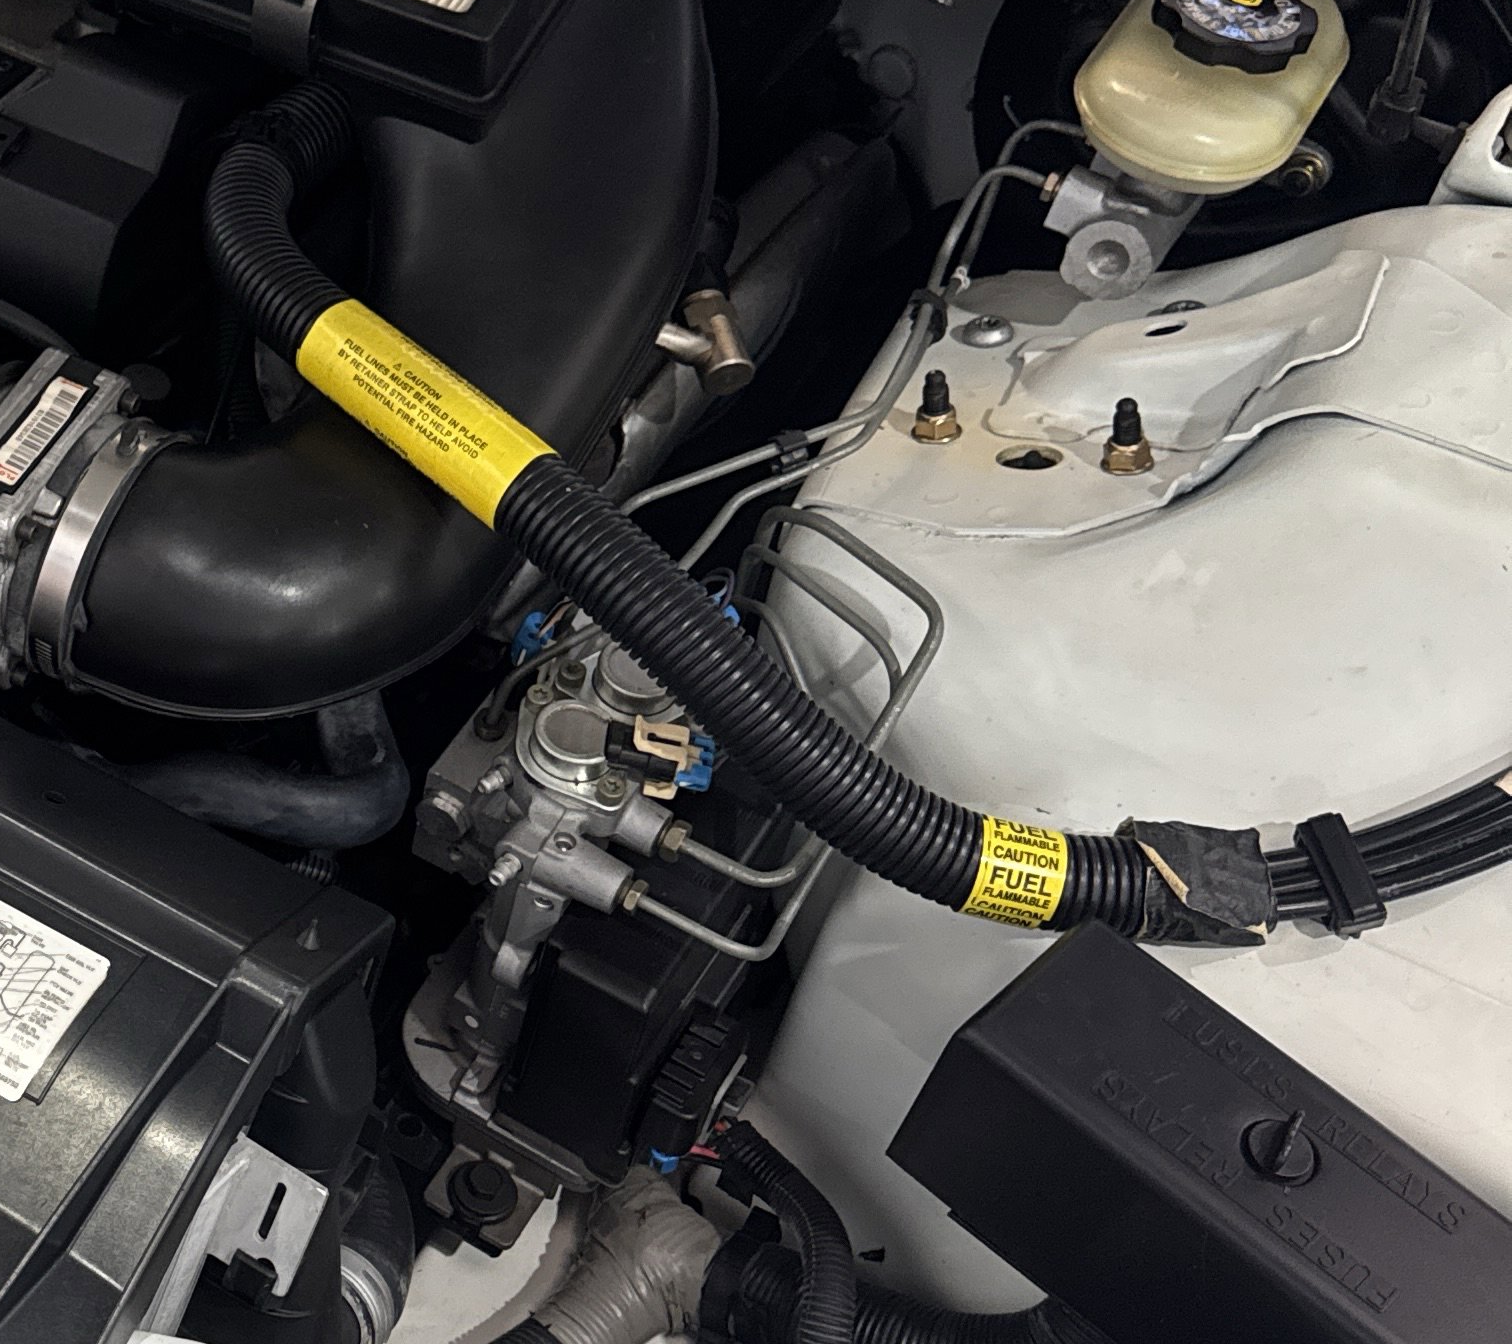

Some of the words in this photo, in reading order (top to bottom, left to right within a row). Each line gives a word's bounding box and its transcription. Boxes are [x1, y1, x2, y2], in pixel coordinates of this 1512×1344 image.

[337, 349, 348, 361] BY
[350, 358, 388, 391] RETAINER
[389, 389, 415, 412] STRAP
[416, 410, 427, 422] TO
[428, 420, 450, 441] HELP
[450, 437, 476, 461] AVOID
[344, 338, 363, 356] FUEL
[365, 354, 388, 376] LINES
[389, 372, 413, 394] MUST
[414, 391, 424, 403] BE
[425, 400, 447, 421] HELD
[448, 418, 458, 429] IN
[458, 426, 486, 451] PLACE
[404, 370, 440, 401] CAUTION
[352, 374, 395, 411] POTENTIAL
[396, 408, 414, 426] FIRE
[415, 423, 449, 453] HAZARD
[993, 829, 1061, 853] FLAMMABLE
[993, 845, 1060, 872] CAUTION
[981, 886, 1051, 909] FLAMMABLE
[988, 865, 1052, 897] FUEL
[1318, 1112, 1465, 1229] RELAYS
[1264, 1203, 1397, 1310] FUSES
